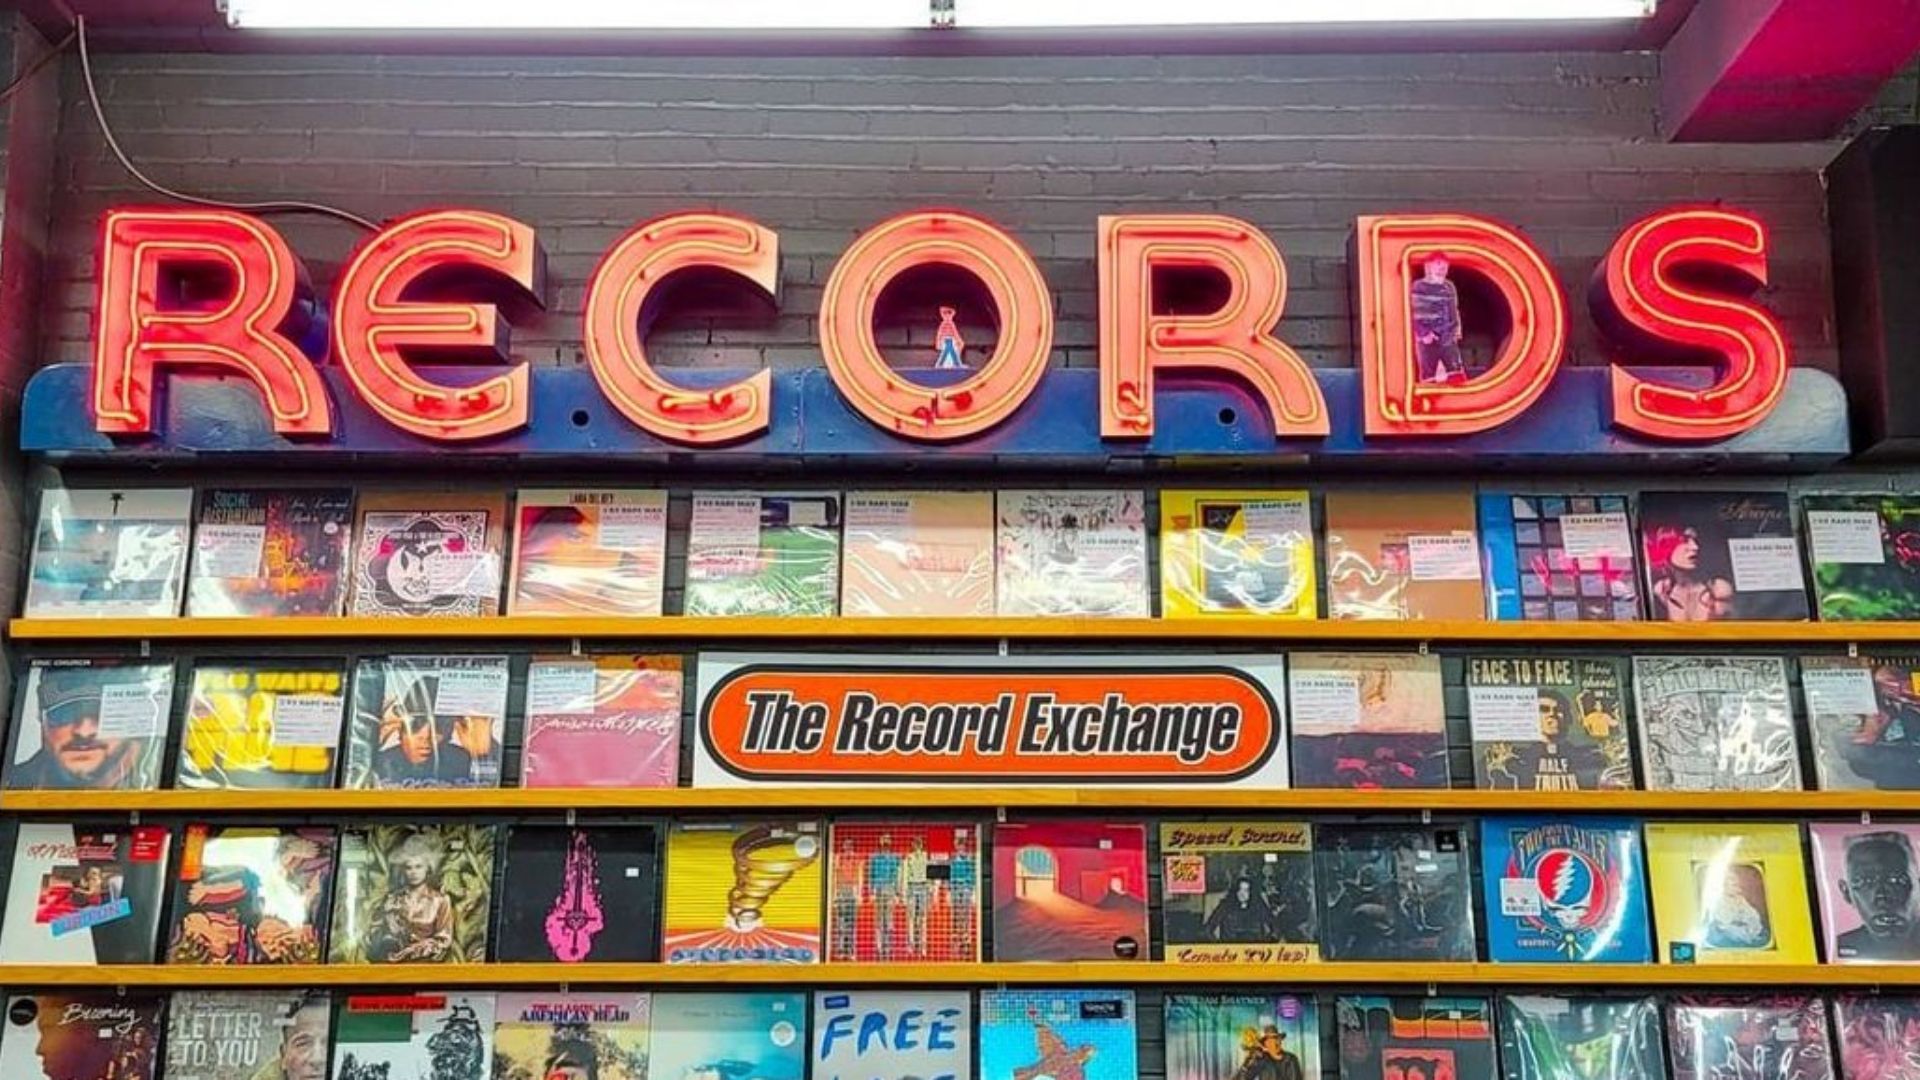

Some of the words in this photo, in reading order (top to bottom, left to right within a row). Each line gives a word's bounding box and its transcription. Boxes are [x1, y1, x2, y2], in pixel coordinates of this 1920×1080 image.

[96, 207, 1789, 442] RECORDS
[1472, 659, 1509, 685] FACE
[1513, 659, 1531, 685] TO
[1534, 659, 1573, 685] FACE
[742, 690, 828, 754] The
[835, 694, 1014, 755] Record
[1018, 694, 1242, 763] Exchange
[1168, 827, 1235, 847] Speed,
[1239, 828, 1306, 846] Sound,
[58, 1003, 142, 1034] Becoming
[177, 1012, 262, 1039] LETTER
[821, 1008, 962, 1061] FREE
[176, 1040, 206, 1066] TO
[214, 1039, 258, 1066] YOU
